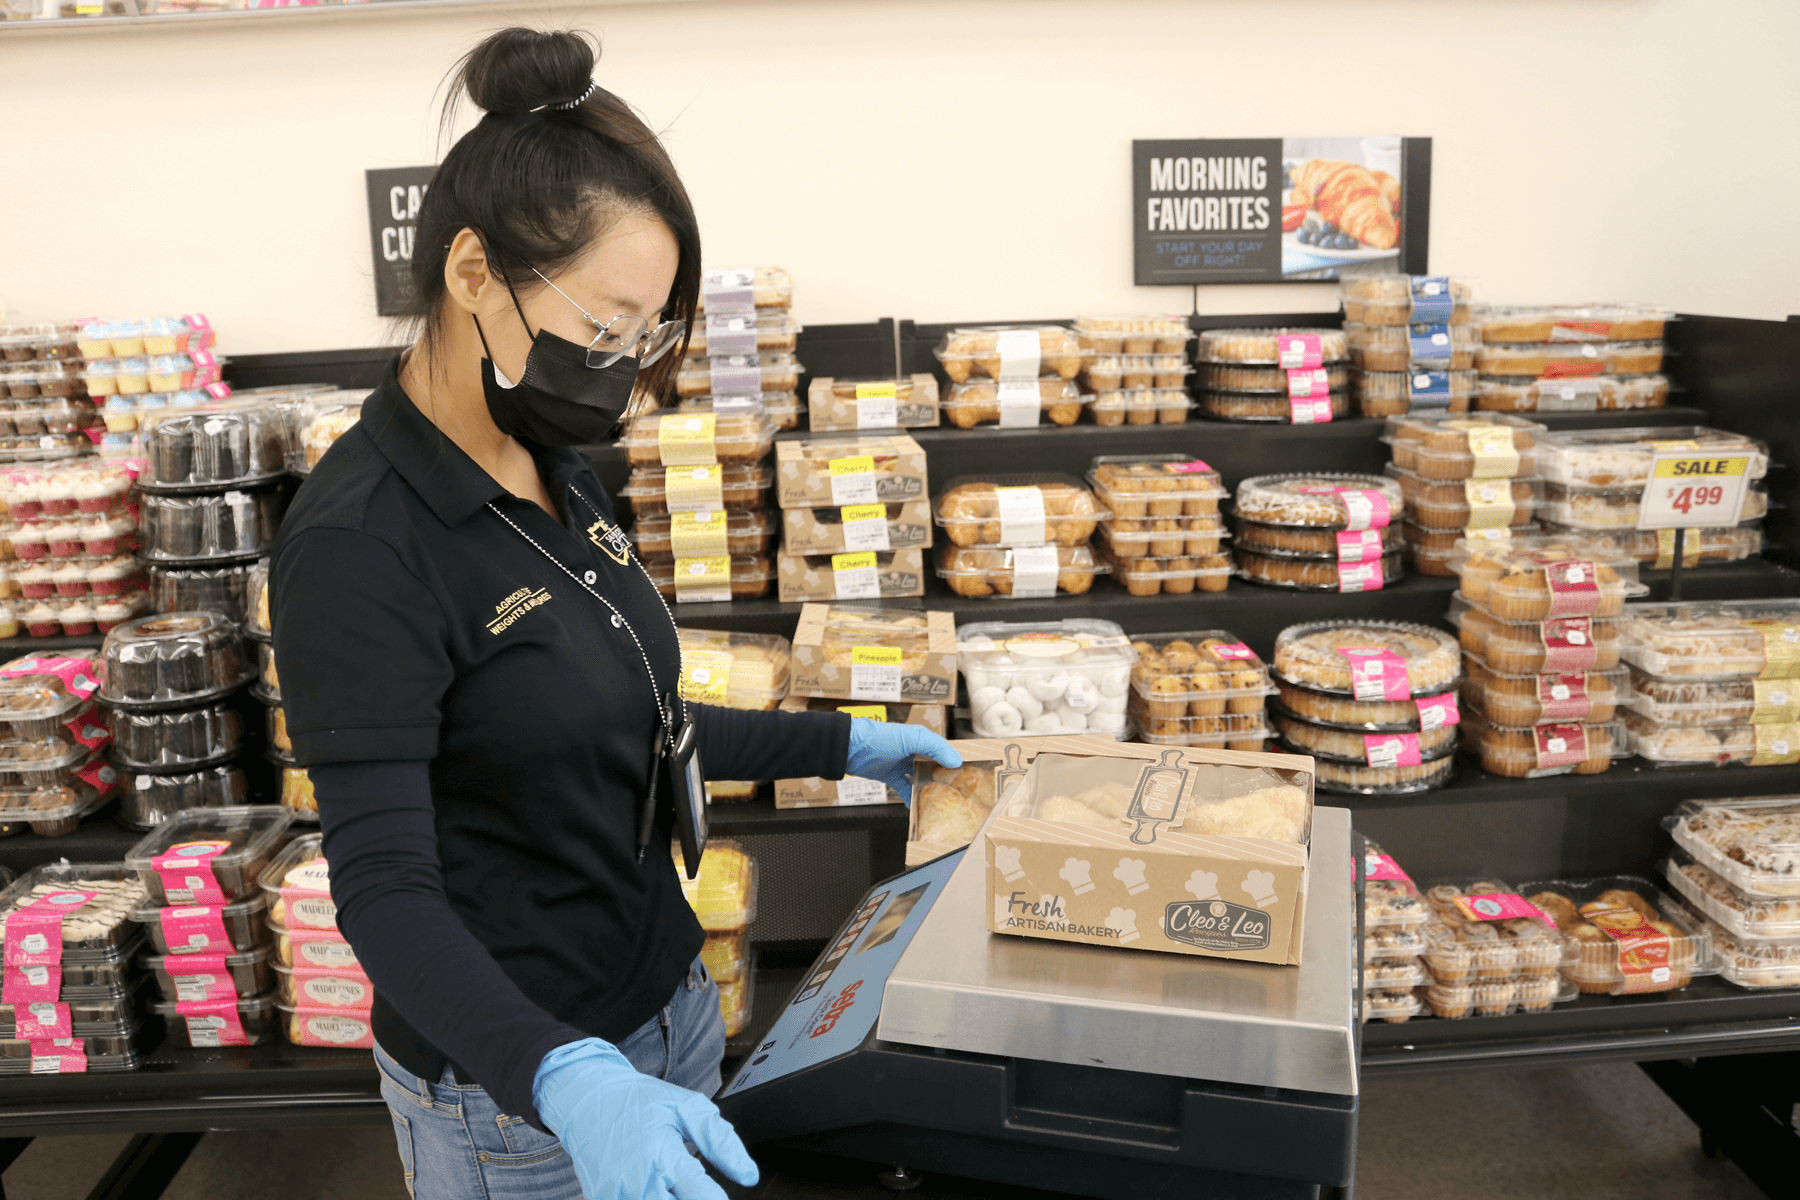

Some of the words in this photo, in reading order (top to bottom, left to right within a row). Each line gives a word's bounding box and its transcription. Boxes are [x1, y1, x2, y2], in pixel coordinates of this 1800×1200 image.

[1150, 156, 1267, 192] MORNING
[389, 184, 428, 221] CA
[1147, 196, 1270, 232] FAVORITES
[1156, 242, 1196, 254] START
[1200, 241, 1235, 254] YOUR
[1237, 241, 1264, 253] DAY
[1174, 255, 1200, 267] OFF
[1672, 460, 1729, 475] SALE
[849, 511, 879, 520] Cherry
[840, 560, 870, 569] Cherry
[489, 606, 526, 636] WEIGHTS
[858, 654, 898, 662] Pineapple
[1007, 891, 1065, 918] Fresh
[1006, 916, 1066, 933] ARTISAN
[1067, 923, 1123, 939] BAKERY
[1170, 904, 1216, 932] Cleo
[1217, 916, 1231, 931] &
[1231, 911, 1264, 939] Leo
[1188, 927, 1227, 938] Recipes
